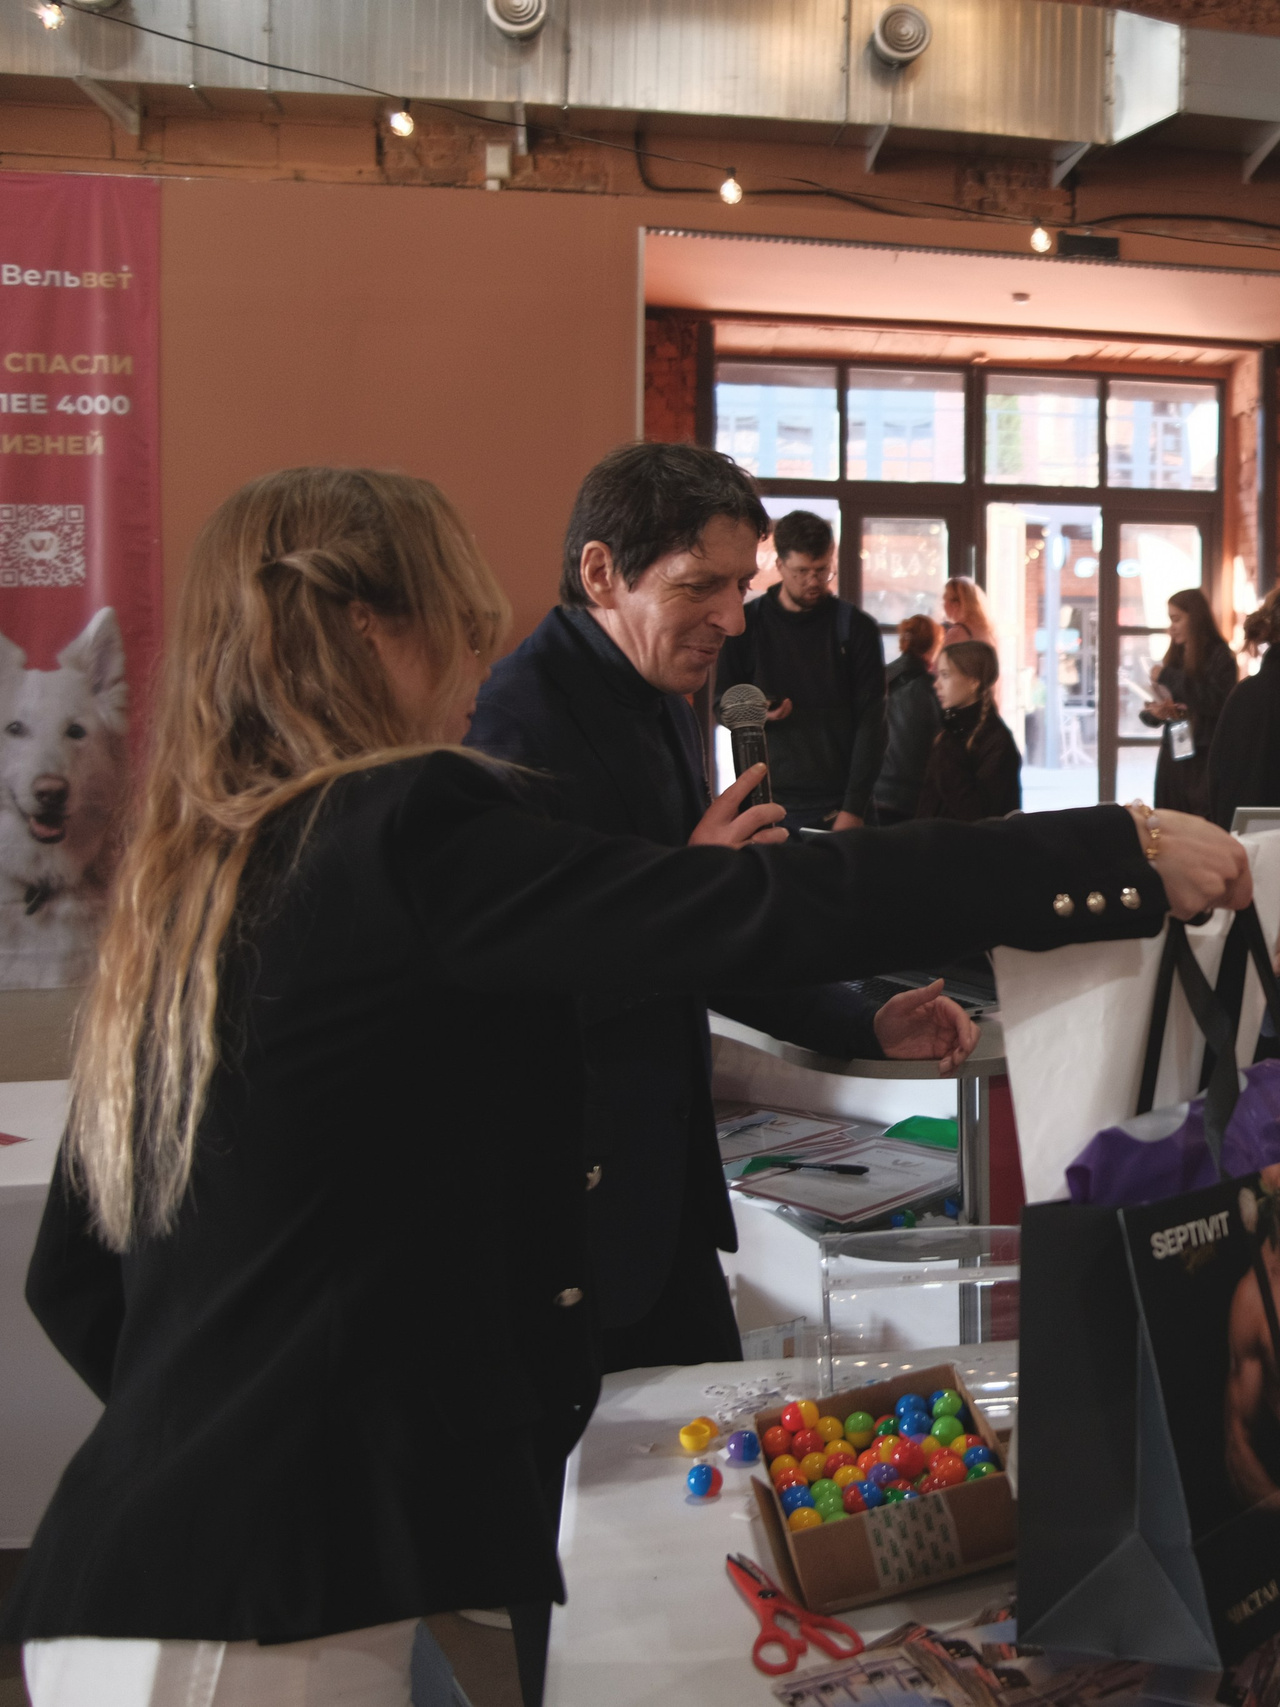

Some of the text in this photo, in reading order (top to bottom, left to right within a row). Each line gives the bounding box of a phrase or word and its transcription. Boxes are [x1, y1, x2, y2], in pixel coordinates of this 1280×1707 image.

[1, 264, 133, 289] Вельвет
[3, 352, 134, 375] СПАСЛИ
[56, 394, 131, 416] 4000
[0, 430, 105, 456] ИЗНЕЙ
